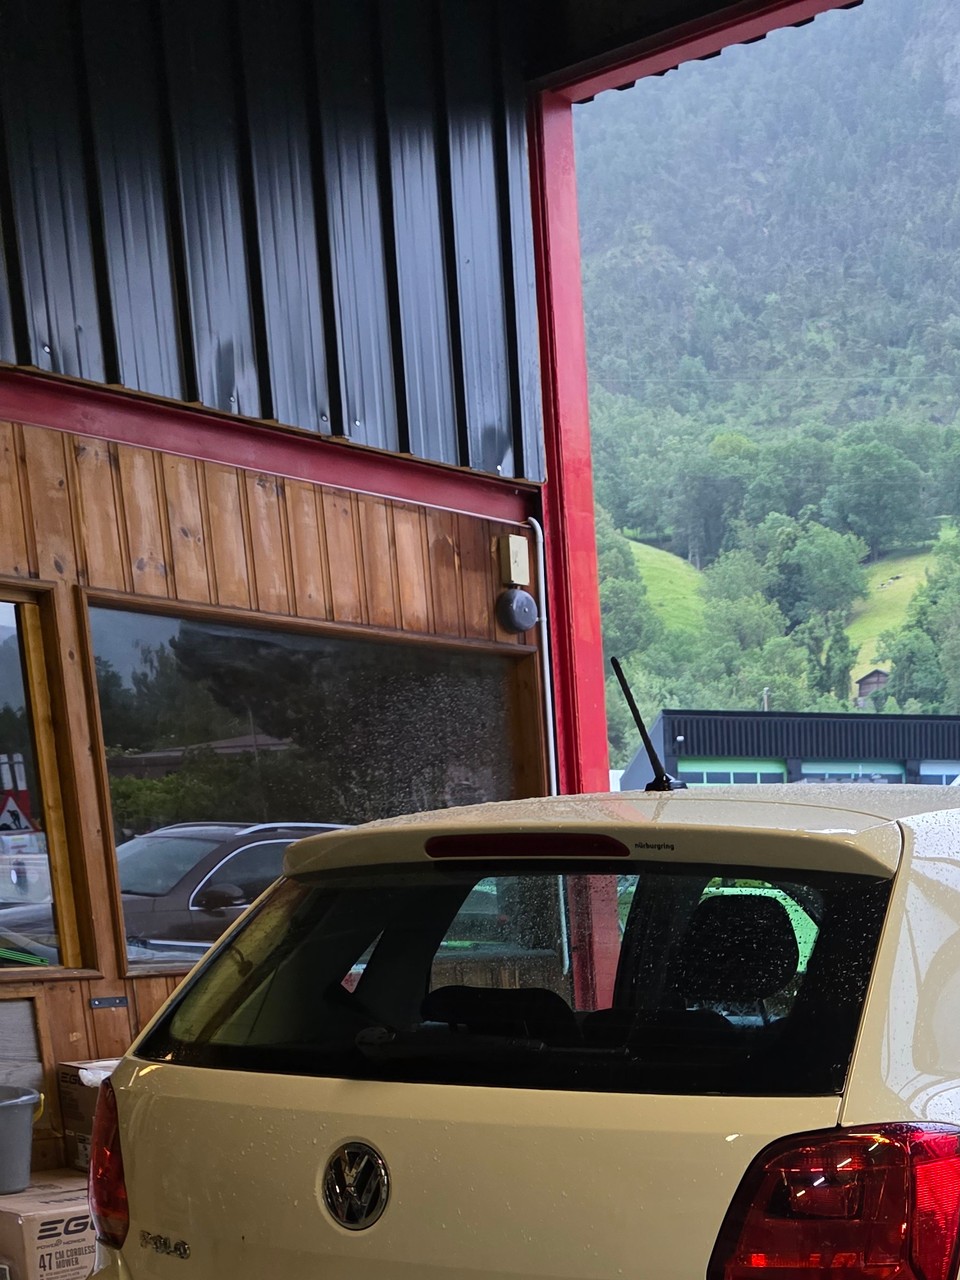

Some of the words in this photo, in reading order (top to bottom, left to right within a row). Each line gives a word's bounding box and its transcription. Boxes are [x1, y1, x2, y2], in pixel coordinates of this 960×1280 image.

[634, 842, 675, 851] nürburgring
[60, 1072, 84, 1086] EG
[39, 1253, 53, 1271] 47
[55, 1250, 65, 1260] CM
[66, 1245, 97, 1258] CORDLESS
[56, 1257, 79, 1269] MOWER
